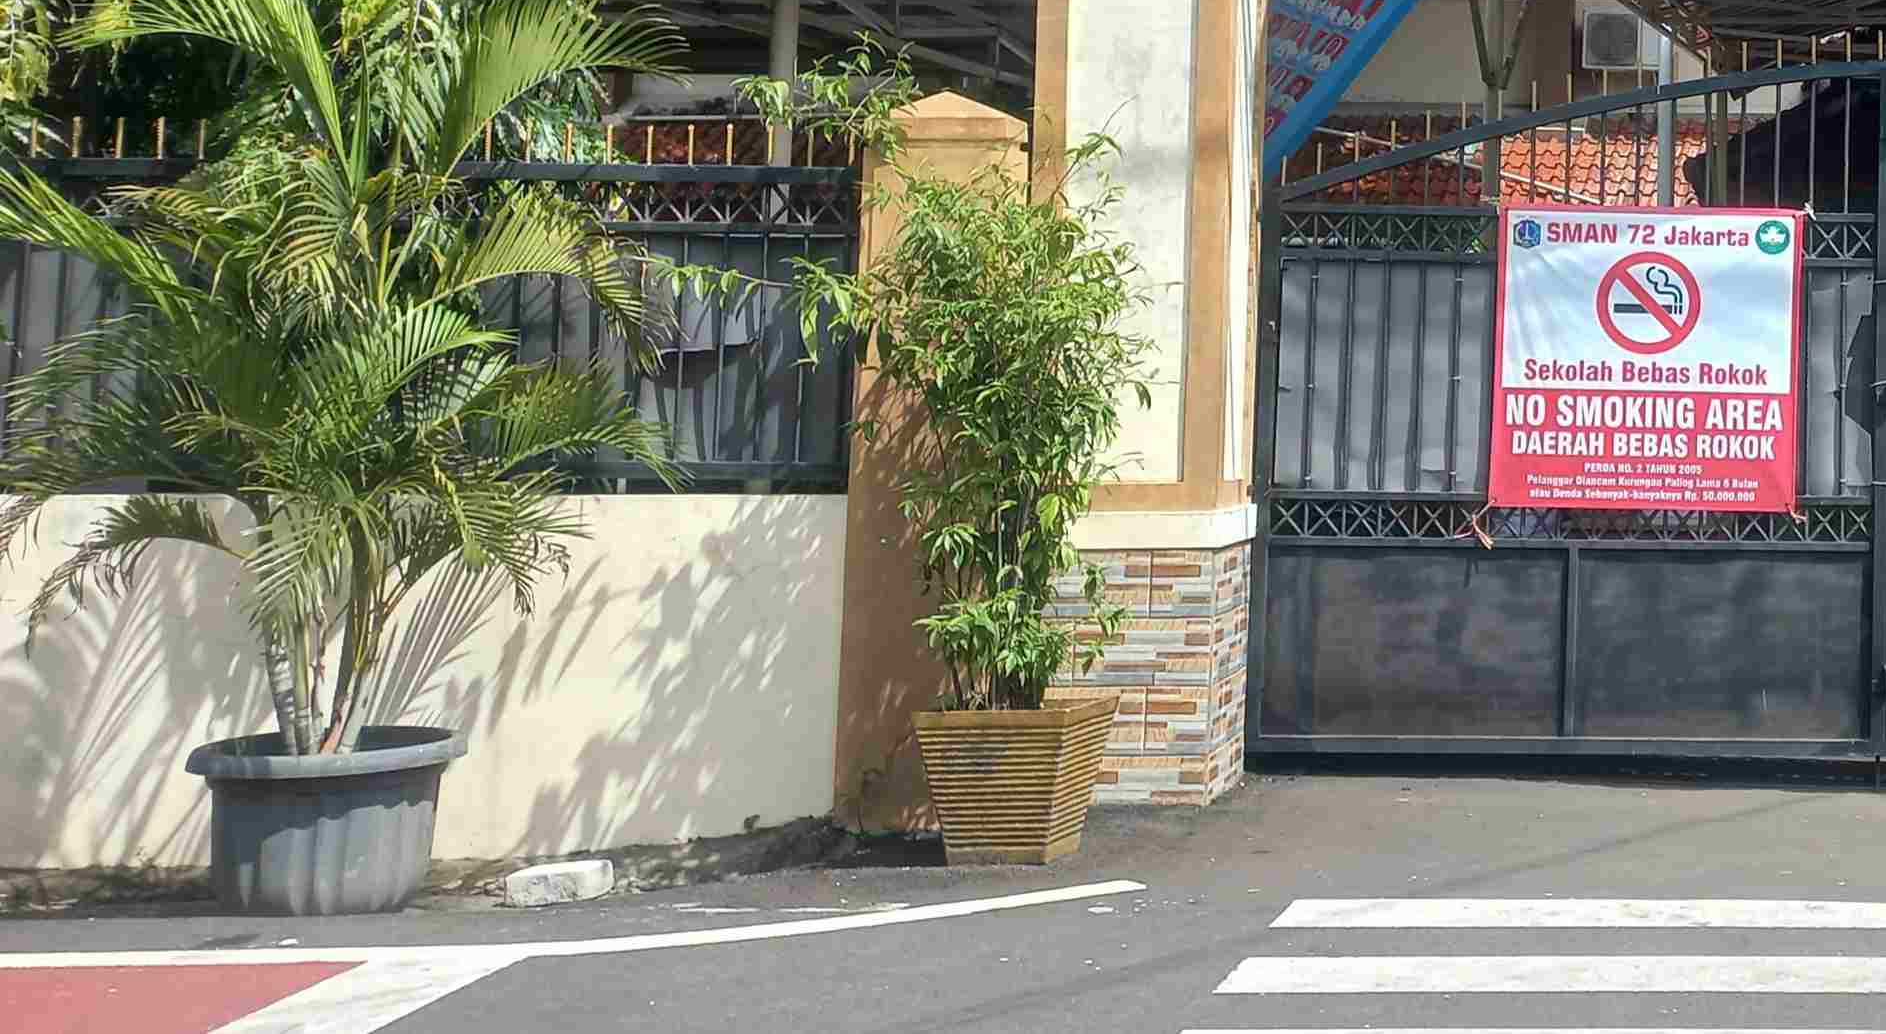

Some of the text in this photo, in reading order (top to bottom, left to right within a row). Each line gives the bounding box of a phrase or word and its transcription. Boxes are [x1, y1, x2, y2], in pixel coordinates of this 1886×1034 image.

[1546, 220, 1750, 247] SMAN 72 Jakarta
[1524, 358, 1768, 386] Sekolah Bebas Rokok
[1505, 393, 1784, 432] NO SMOKING AREA
[1511, 429, 1776, 461] DAERAH BEBAS ROKOK
[1526, 474, 1574, 487] Pelanggar
[1575, 474, 1617, 487] Diancam
[1618, 475, 1662, 489] Kurungan
[1696, 477, 1721, 488] Lama
[1732, 477, 1760, 489] Bulan
[1583, 462, 1616, 473] PERDA
[1636, 463, 1643, 474] 2
[1646, 463, 1677, 474] TAHUN
[1529, 488, 1756, 502] atau Denda Sebanyak-banyaknya Rp. 50.000.000
